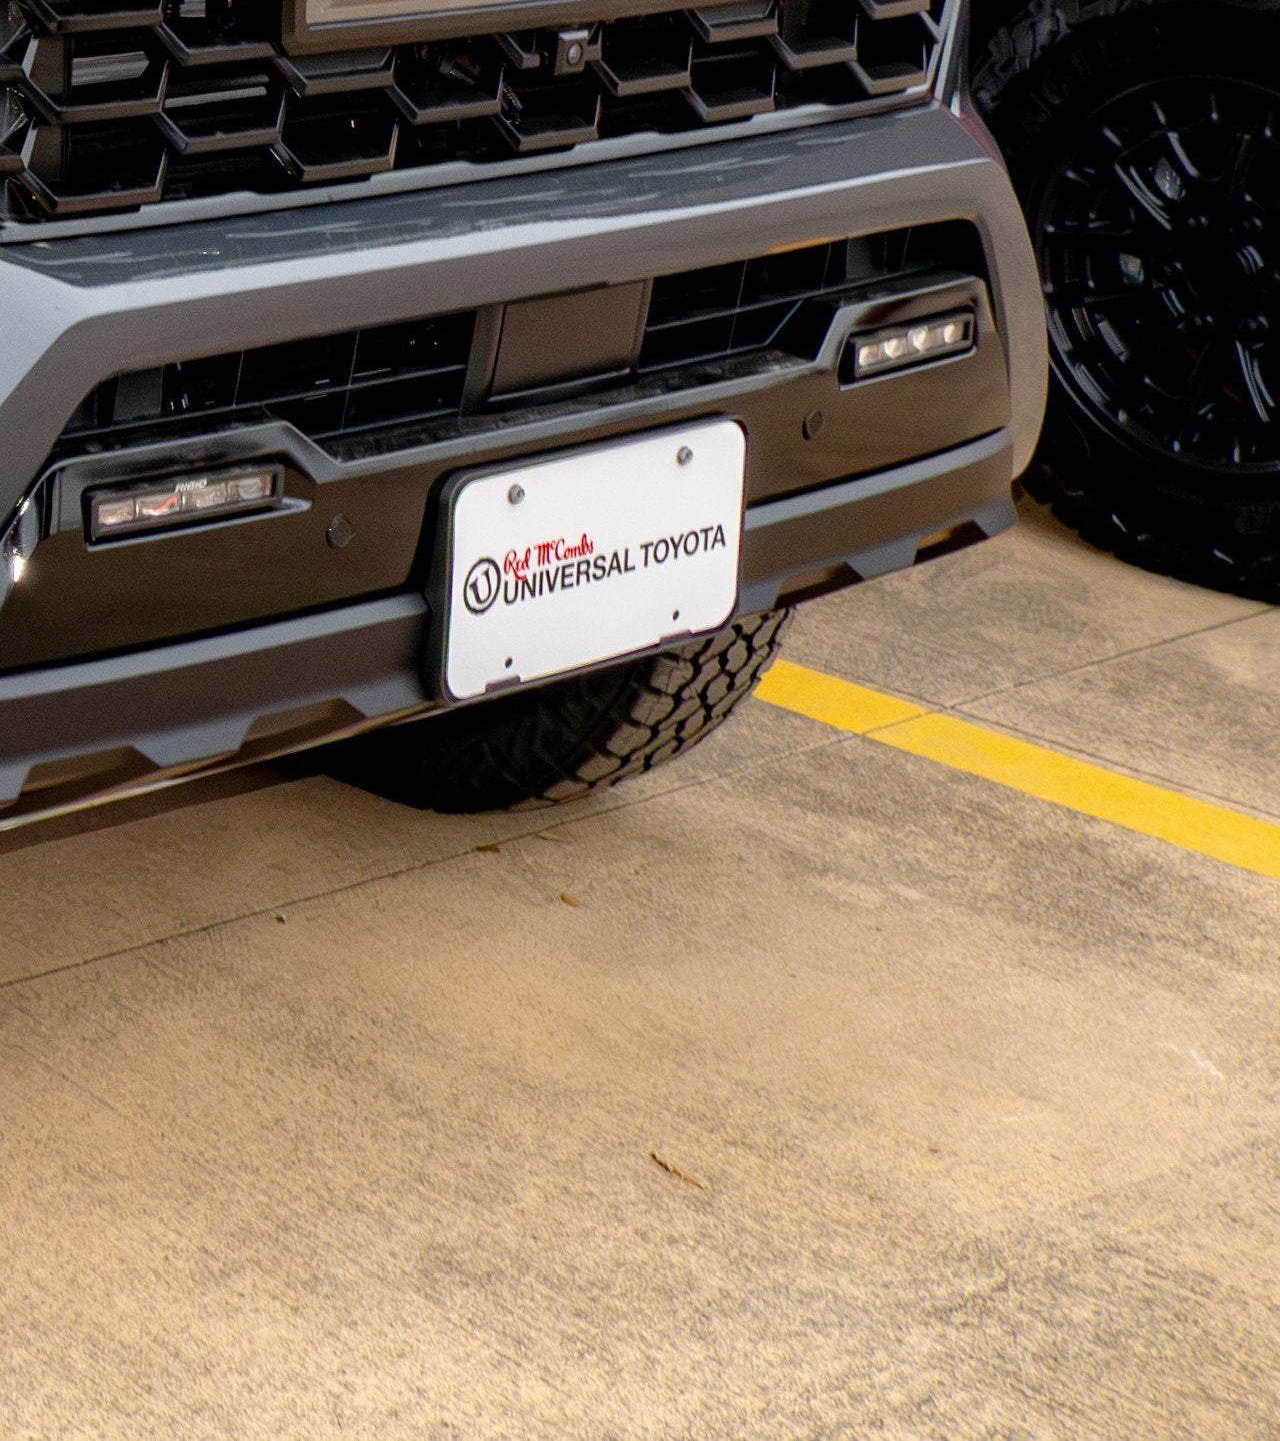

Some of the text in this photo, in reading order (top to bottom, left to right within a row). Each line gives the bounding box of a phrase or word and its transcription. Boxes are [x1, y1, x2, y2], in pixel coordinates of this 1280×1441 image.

[503, 532, 594, 583] Red McCombs
[503, 524, 727, 605] UNIVERSAL TOYOTA
